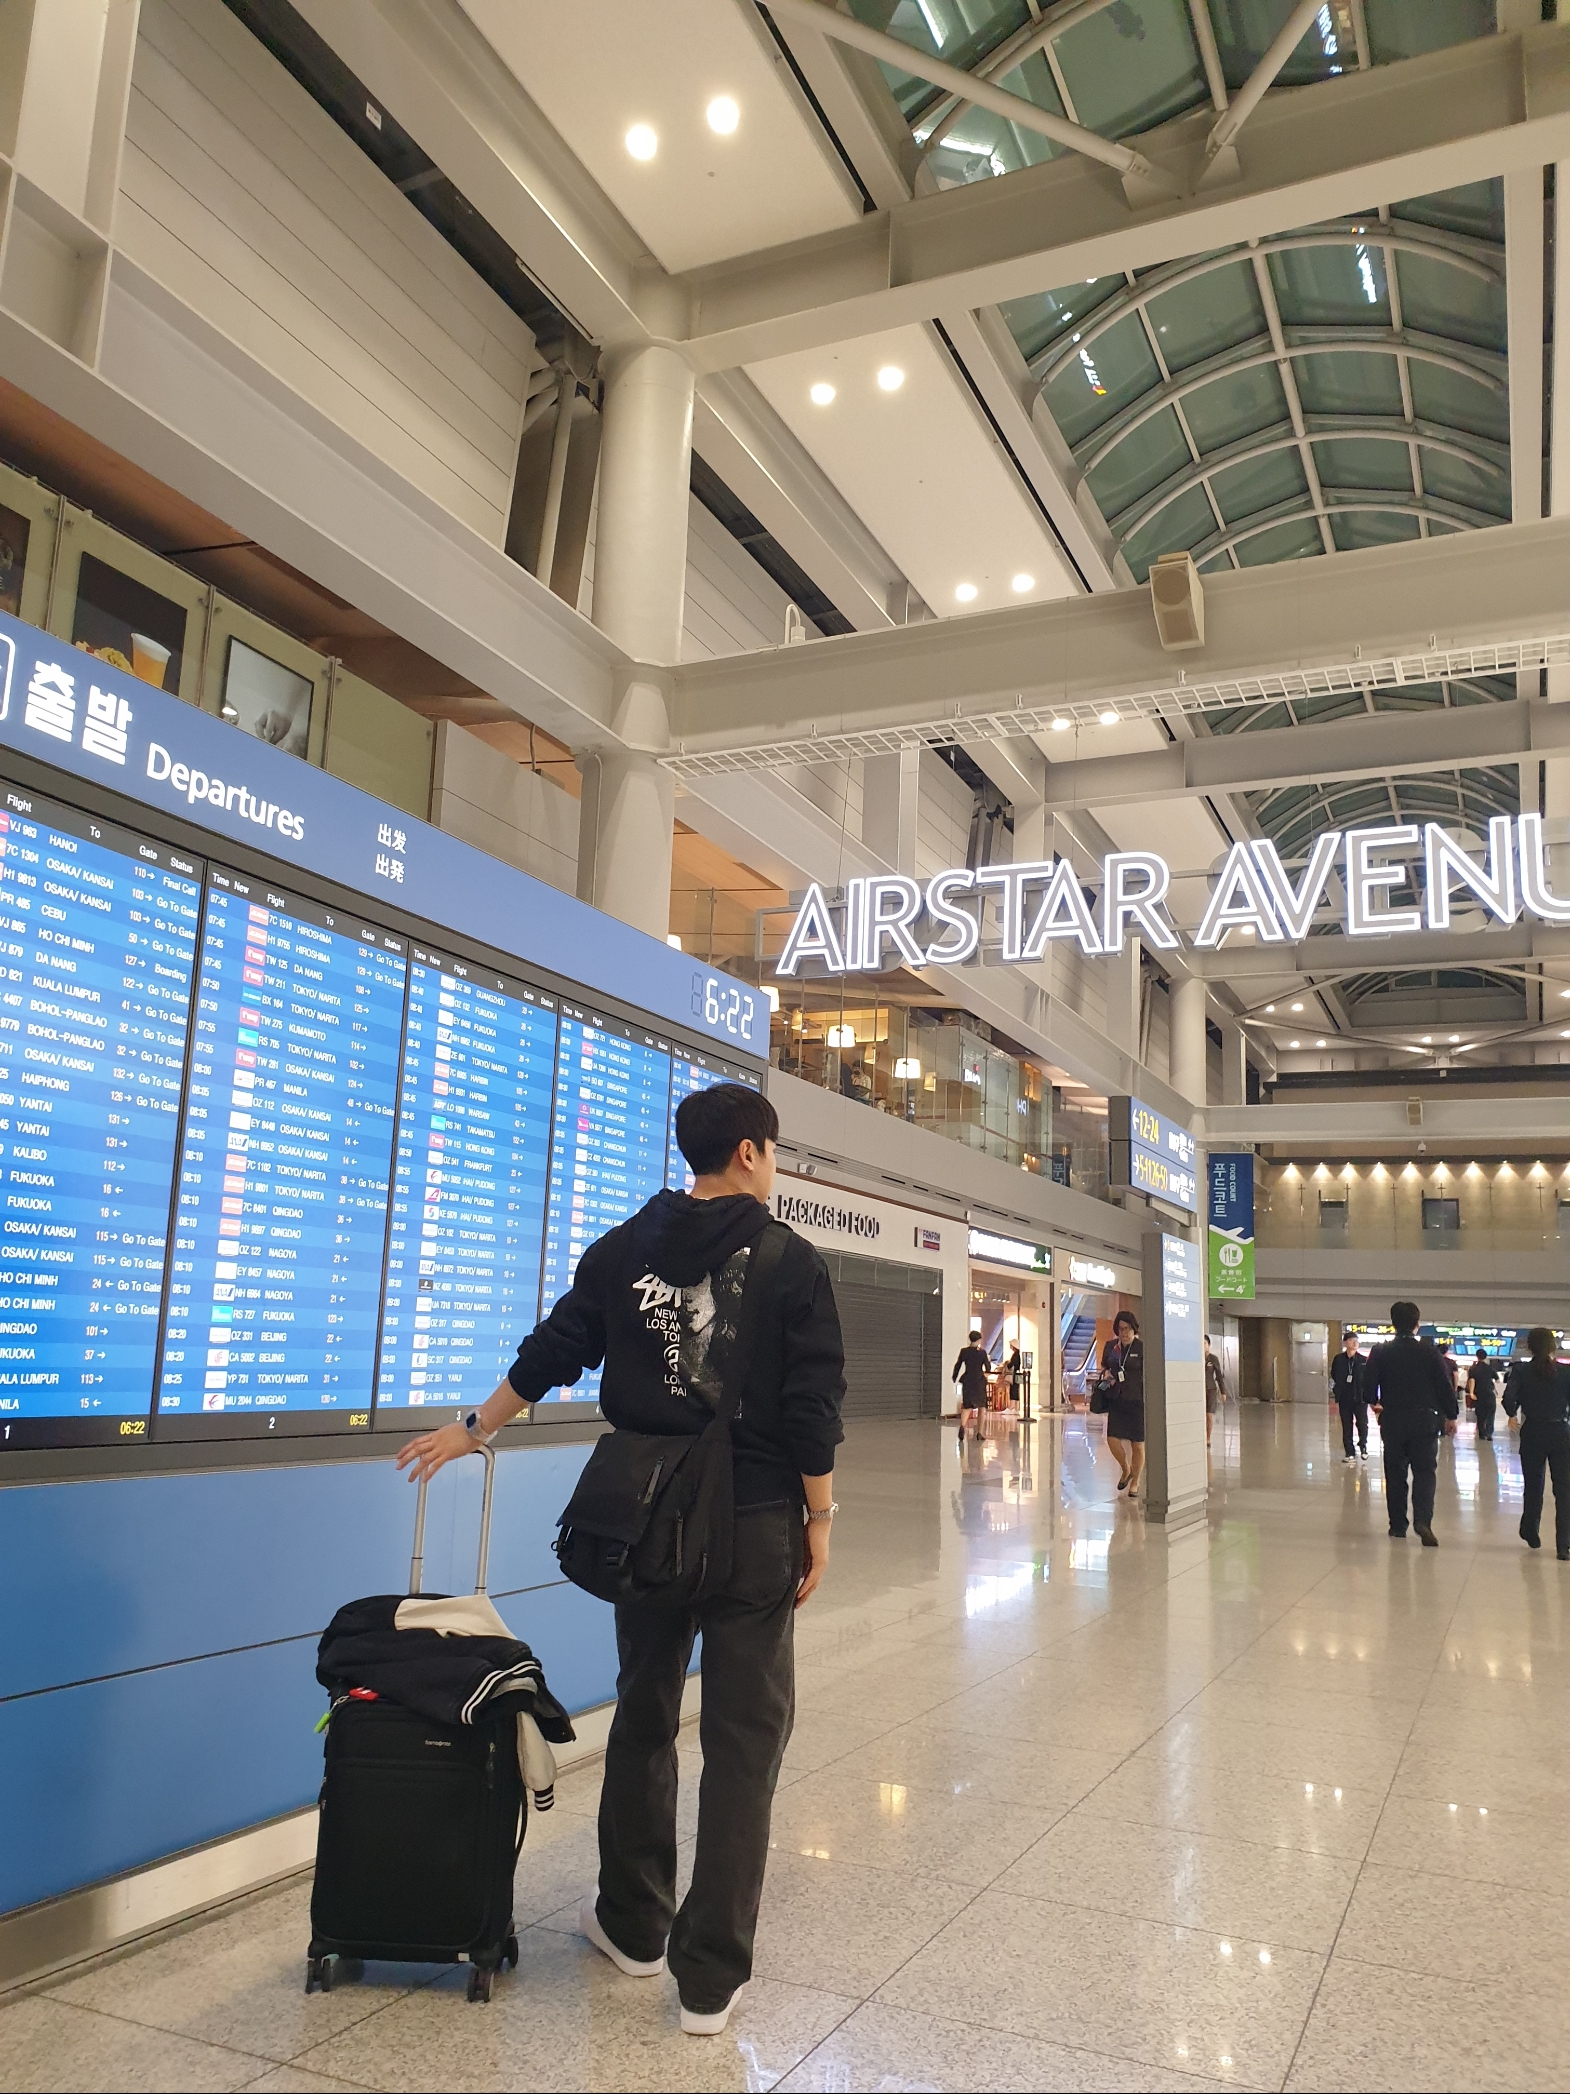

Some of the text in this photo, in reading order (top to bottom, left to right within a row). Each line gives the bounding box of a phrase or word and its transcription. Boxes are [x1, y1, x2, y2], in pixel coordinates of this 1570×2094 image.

[25, 660, 133, 766] 출발
[146, 742, 305, 841] Departures
[6, 793, 193, 873] Flight To Gate Status
[377, 822, 407, 855] 出发
[9, 819, 196, 896] VJ 963 HANOI 110 Final Call
[375, 853, 405, 884] 出発
[6, 843, 197, 918] 7C 1304 OSAKA/ KANSAI 103 Go To Gate
[17, 872, 36, 887] 9813
[43, 881, 79, 901] OSAKA/
[80, 893, 111, 912] KANSAI
[129, 910, 141, 922] 103
[154, 918, 165, 930] Go
[167, 922, 177, 933] To
[178, 926, 195, 940] Gate
[212, 872, 401, 951] Time New Flight To Gate Status
[775, 850, 1180, 976] AIRSTAR
[1, 891, 14, 905] PR
[41, 904, 66, 921] CEBU
[128, 932, 137, 943] 50
[152, 940, 163, 951] Go
[165, 943, 174, 955] To
[176, 947, 193, 961] Gate
[210, 893, 227, 907] 07:45
[269, 914, 277, 924] 7C
[297, 925, 332, 944] HIROSHIMA
[376, 953, 384, 963] Go
[385, 956, 392, 966] To
[393, 959, 406, 971] Gate
[38, 927, 53, 941] HO
[54, 932, 70, 946] CHI
[71, 937, 94, 953] MINH
[125, 954, 137, 965] 127
[154, 963, 186, 983] Boarding
[413, 948, 503, 989] Time New Flight To
[35, 951, 48, 964] DA
[50, 956, 76, 972] NANG
[122, 977, 135, 988] 122
[147, 984, 159, 995] Go
[160, 987, 170, 998] To
[171, 990, 189, 1003] Gate
[204, 956, 221, 969] 07:45
[263, 974, 274, 985] TW
[292, 983, 317, 999] TOKYO/
[318, 992, 340, 1006] NARITA
[29, 999, 107, 1027] BOHOL-PANGLAO
[119, 1022, 128, 1033] 32
[32, 975, 62, 992] KUALA
[64, 984, 100, 1002] LUMPUR
[121, 1000, 130, 1010] 41
[145, 1006, 156, 1017] Go
[158, 1009, 168, 1020] To
[169, 1012, 187, 1025] Gate
[705, 977, 754, 1040] 6:22
[200, 998, 217, 1011] 07:50
[260, 1015, 271, 1025] TW
[288, 1023, 326, 1041] KUMAMOTO
[24, 1047, 125, 1078] OSAKA/ KANSAI 132
[21, 1072, 123, 1101] HAIPHONG 126
[19, 1096, 120, 1124] YANTAI 131
[281, 1103, 307, 1117] OSAKA/
[308, 1109, 331, 1121] KANSAI
[346, 1117, 352, 1126] 14
[1138, 1109, 1160, 1145] 12-24
[13, 1145, 116, 1171] KALIBO 112
[10, 1170, 111, 1194] FUKUOKA 16
[1213, 1163, 1228, 1218] 푸드코트
[1229, 1182, 1237, 1202] COURT
[4, 1220, 166, 1247] OSAKA/ KANSAI 115 Go To Gate
[777, 1194, 880, 1239] PACKAGED FOOD
[15, 1272, 32, 1284] CHI
[34, 1274, 58, 1285] MINH
[92, 1278, 101, 1288] 24
[646, 1318, 666, 1330] LOS
[654, 1307, 678, 1321] NEW
[20, 1373, 94, 1384] LUMPUR 113
[4, 1425, 10, 1439] 1
[119, 1421, 145, 1434] 06:22
[268, 1416, 275, 1429] 2
[349, 1413, 368, 1425] 06:22
[456, 1410, 461, 1421] 3
